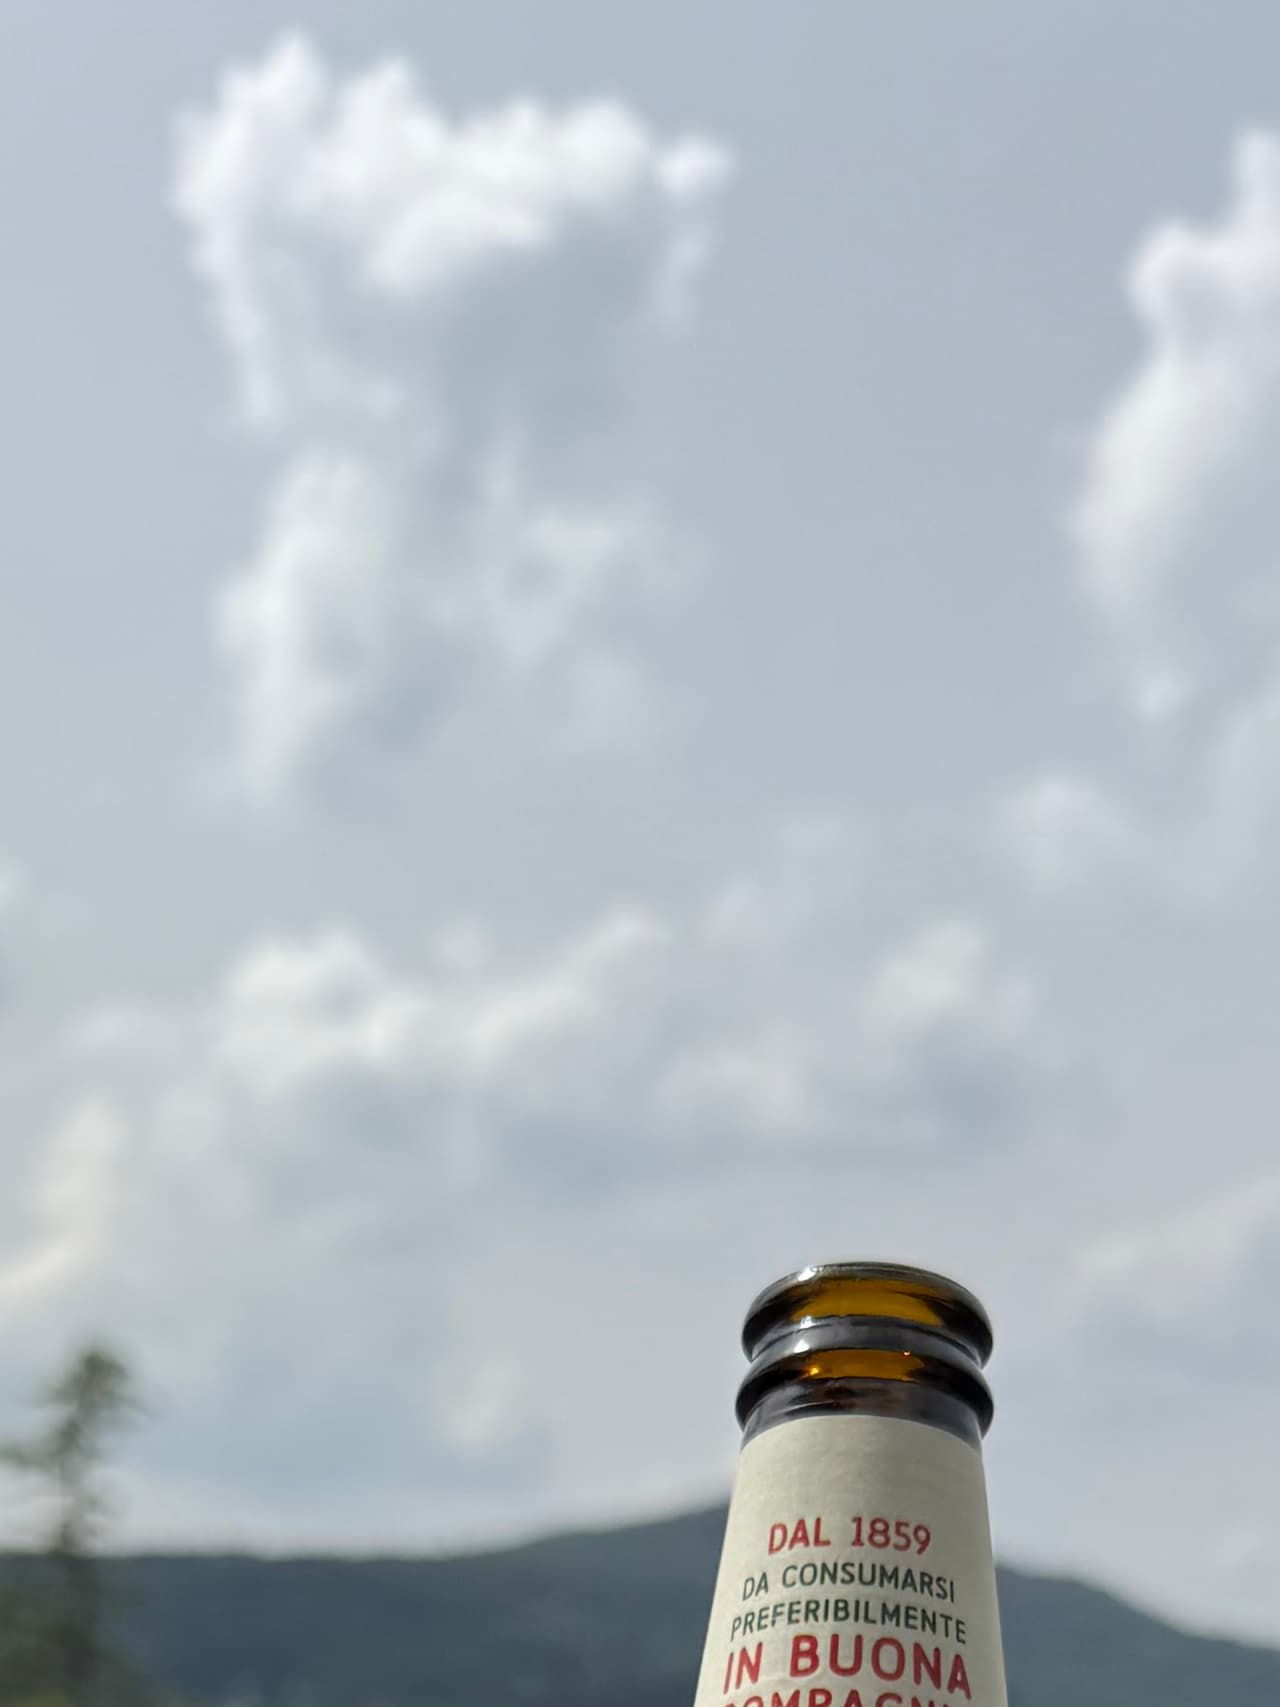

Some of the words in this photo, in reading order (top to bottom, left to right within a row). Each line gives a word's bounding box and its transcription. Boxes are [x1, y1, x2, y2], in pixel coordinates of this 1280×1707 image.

[768, 1516, 830, 1554] DAL
[851, 1515, 932, 1556] 1859
[742, 1573, 770, 1601] DA
[781, 1561, 955, 1603] CONSUMARSI
[730, 1597, 967, 1644] PREFERIBILMENTE
[722, 1642, 765, 1696] IN
[788, 1633, 972, 1700] BUONA
